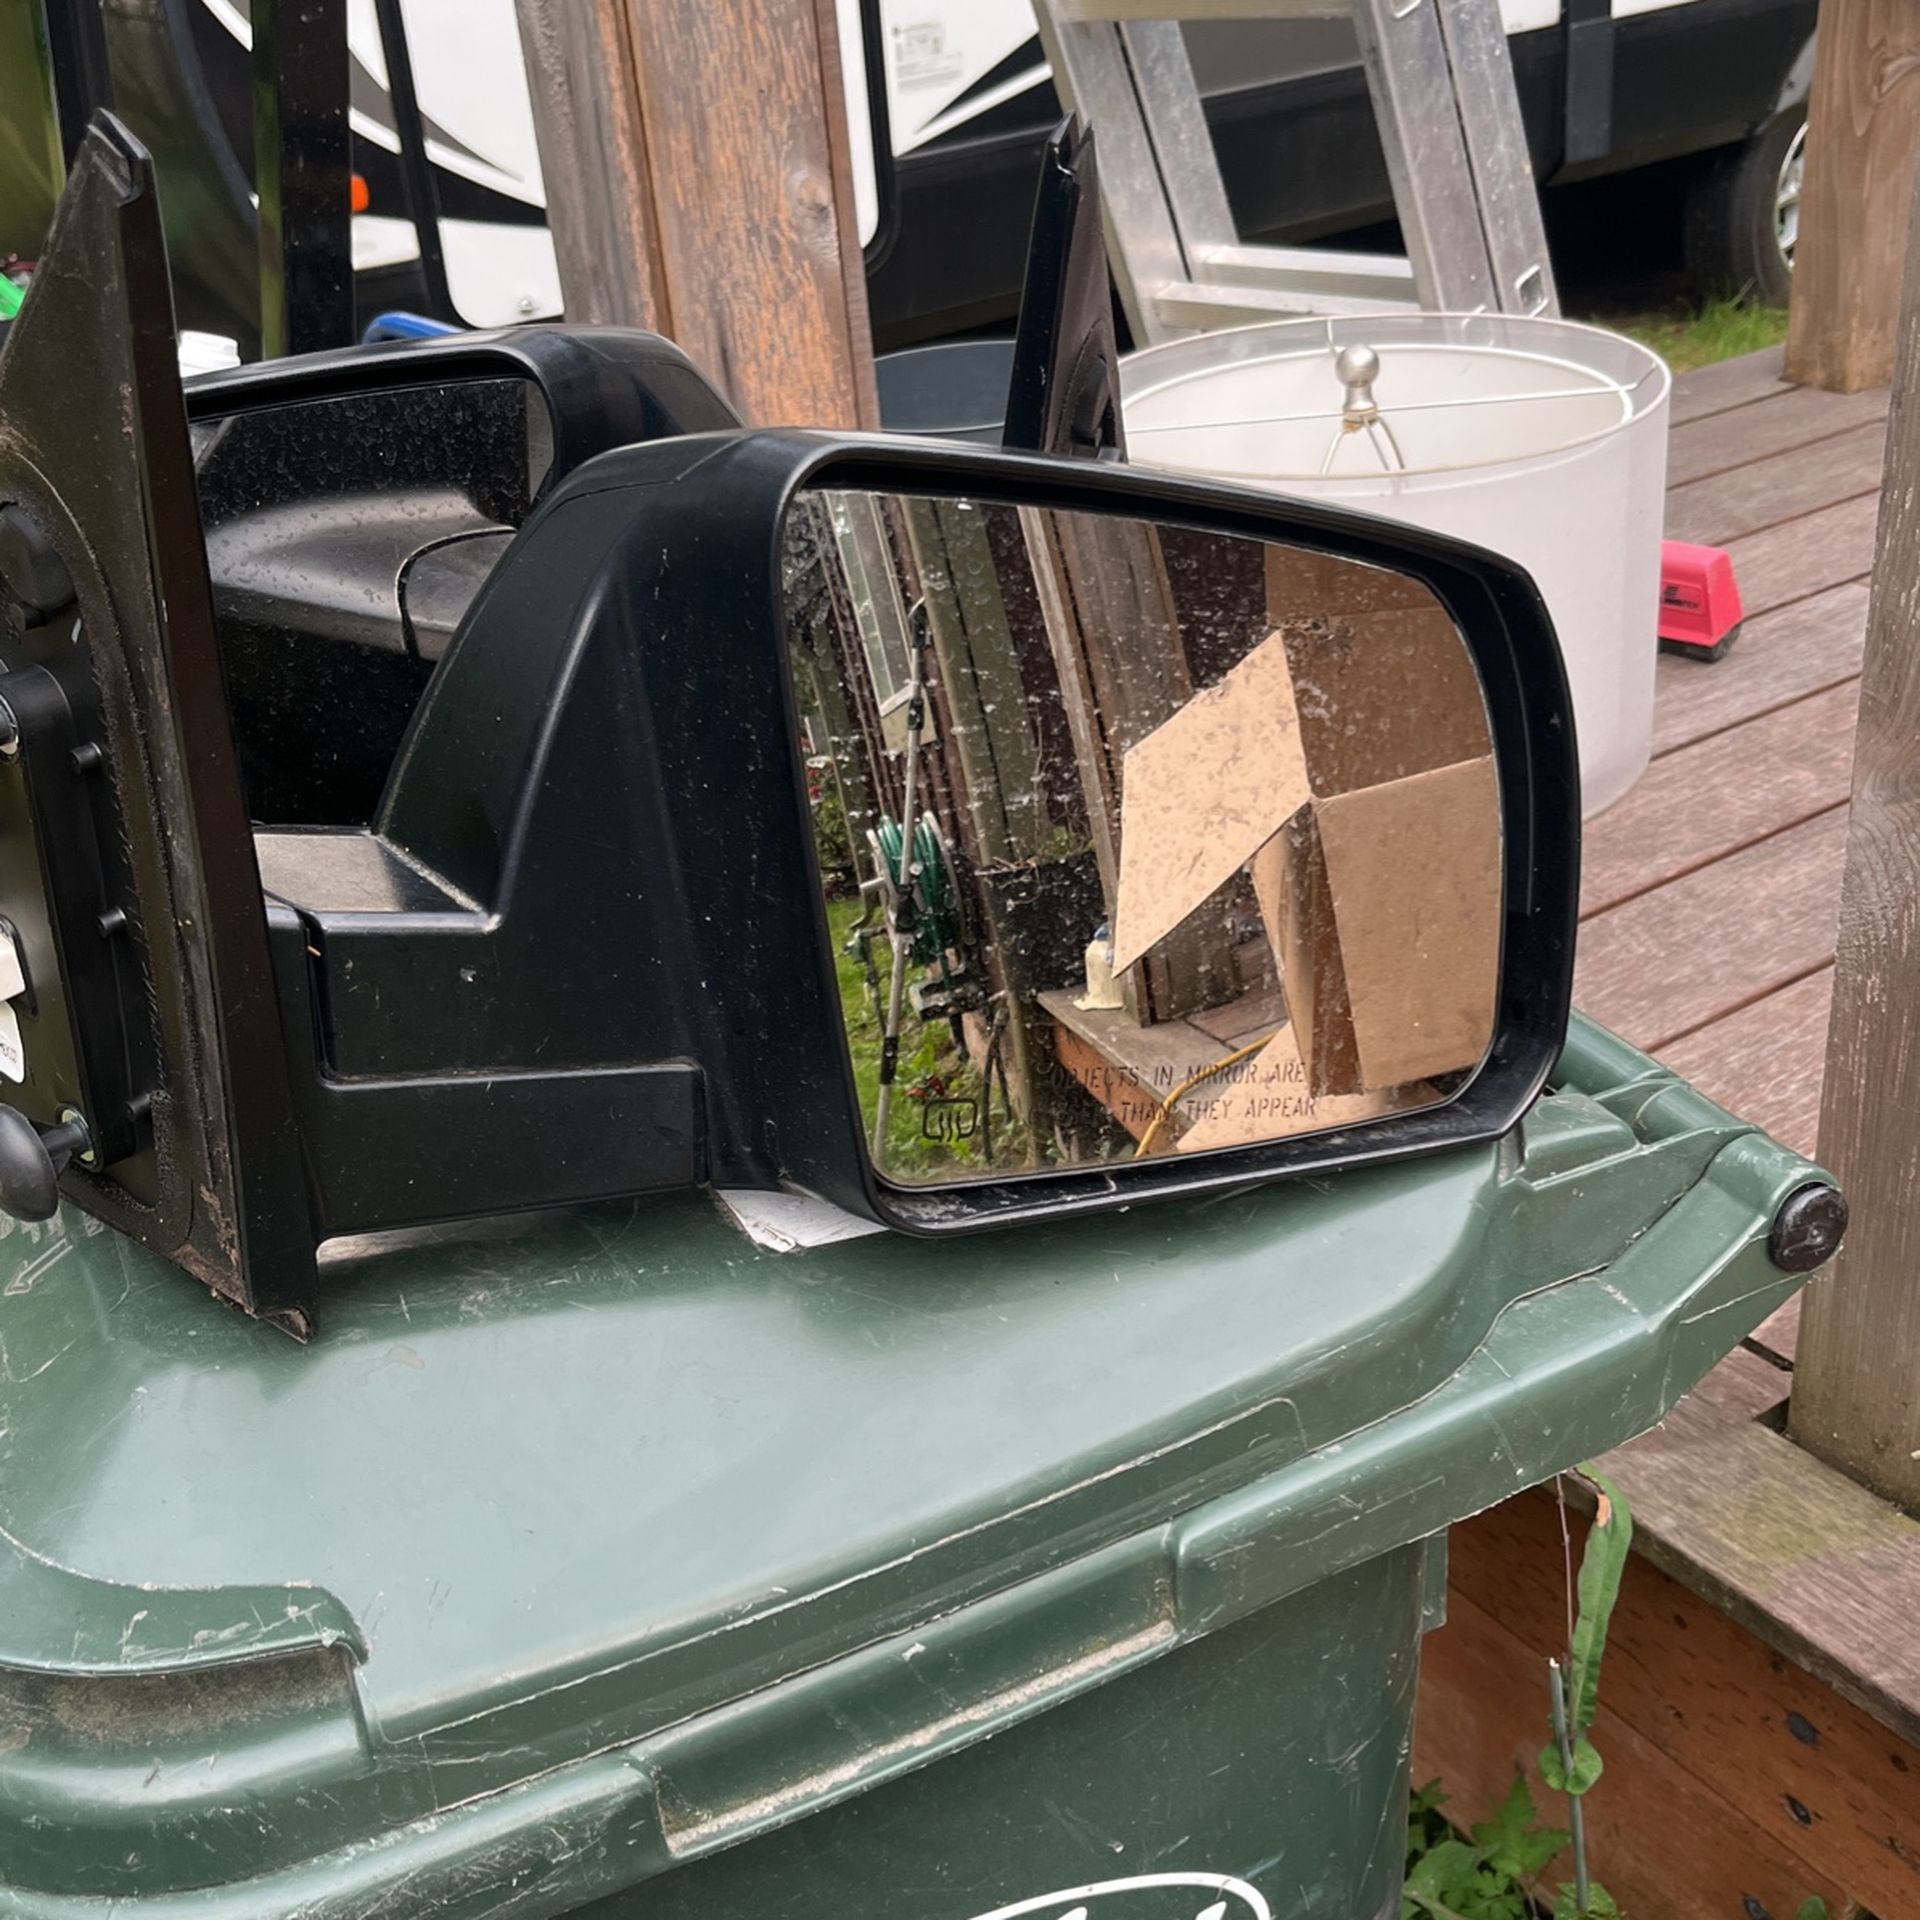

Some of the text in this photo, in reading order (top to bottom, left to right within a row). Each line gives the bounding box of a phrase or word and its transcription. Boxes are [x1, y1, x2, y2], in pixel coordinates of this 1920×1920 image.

[1153, 1064, 1174, 1087] IN
[1186, 1063, 1258, 1085] MIRROR
[1270, 1062, 1307, 1083] ARE
[1121, 1100, 1172, 1122] THAN
[1186, 1098, 1233, 1121] THEY
[1244, 1096, 1316, 1119] APPEAR
